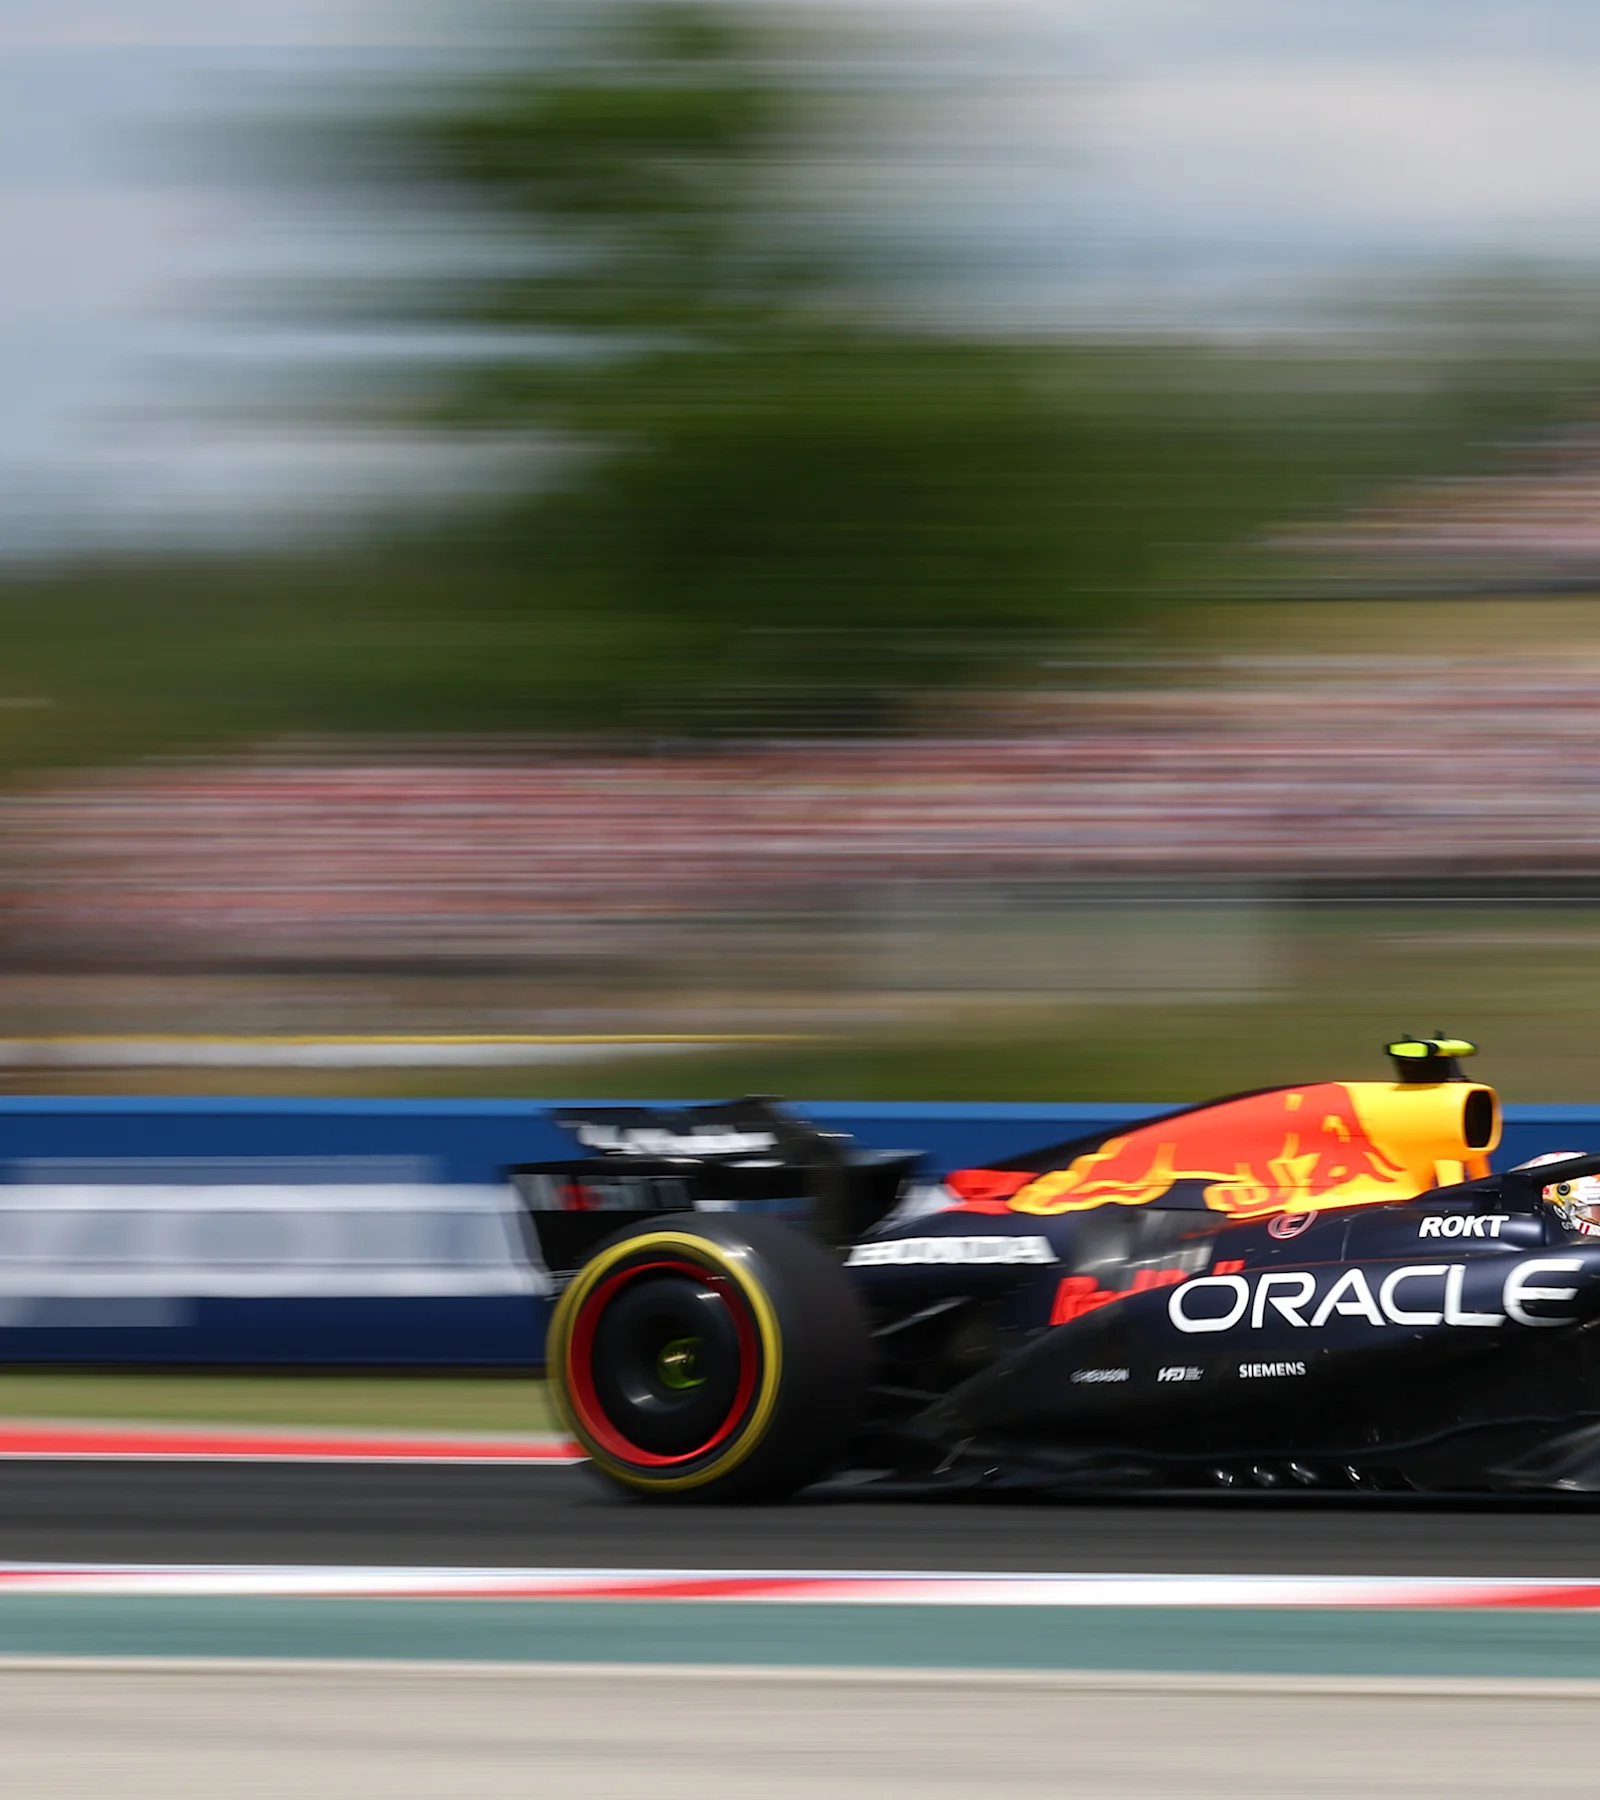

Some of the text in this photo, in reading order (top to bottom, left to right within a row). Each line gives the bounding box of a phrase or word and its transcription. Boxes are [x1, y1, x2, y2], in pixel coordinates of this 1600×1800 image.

[1418, 1215, 1510, 1238] ROKT
[1168, 1258, 1585, 1333] ORACLE
[1239, 1361, 1306, 1379] SIEMENS
